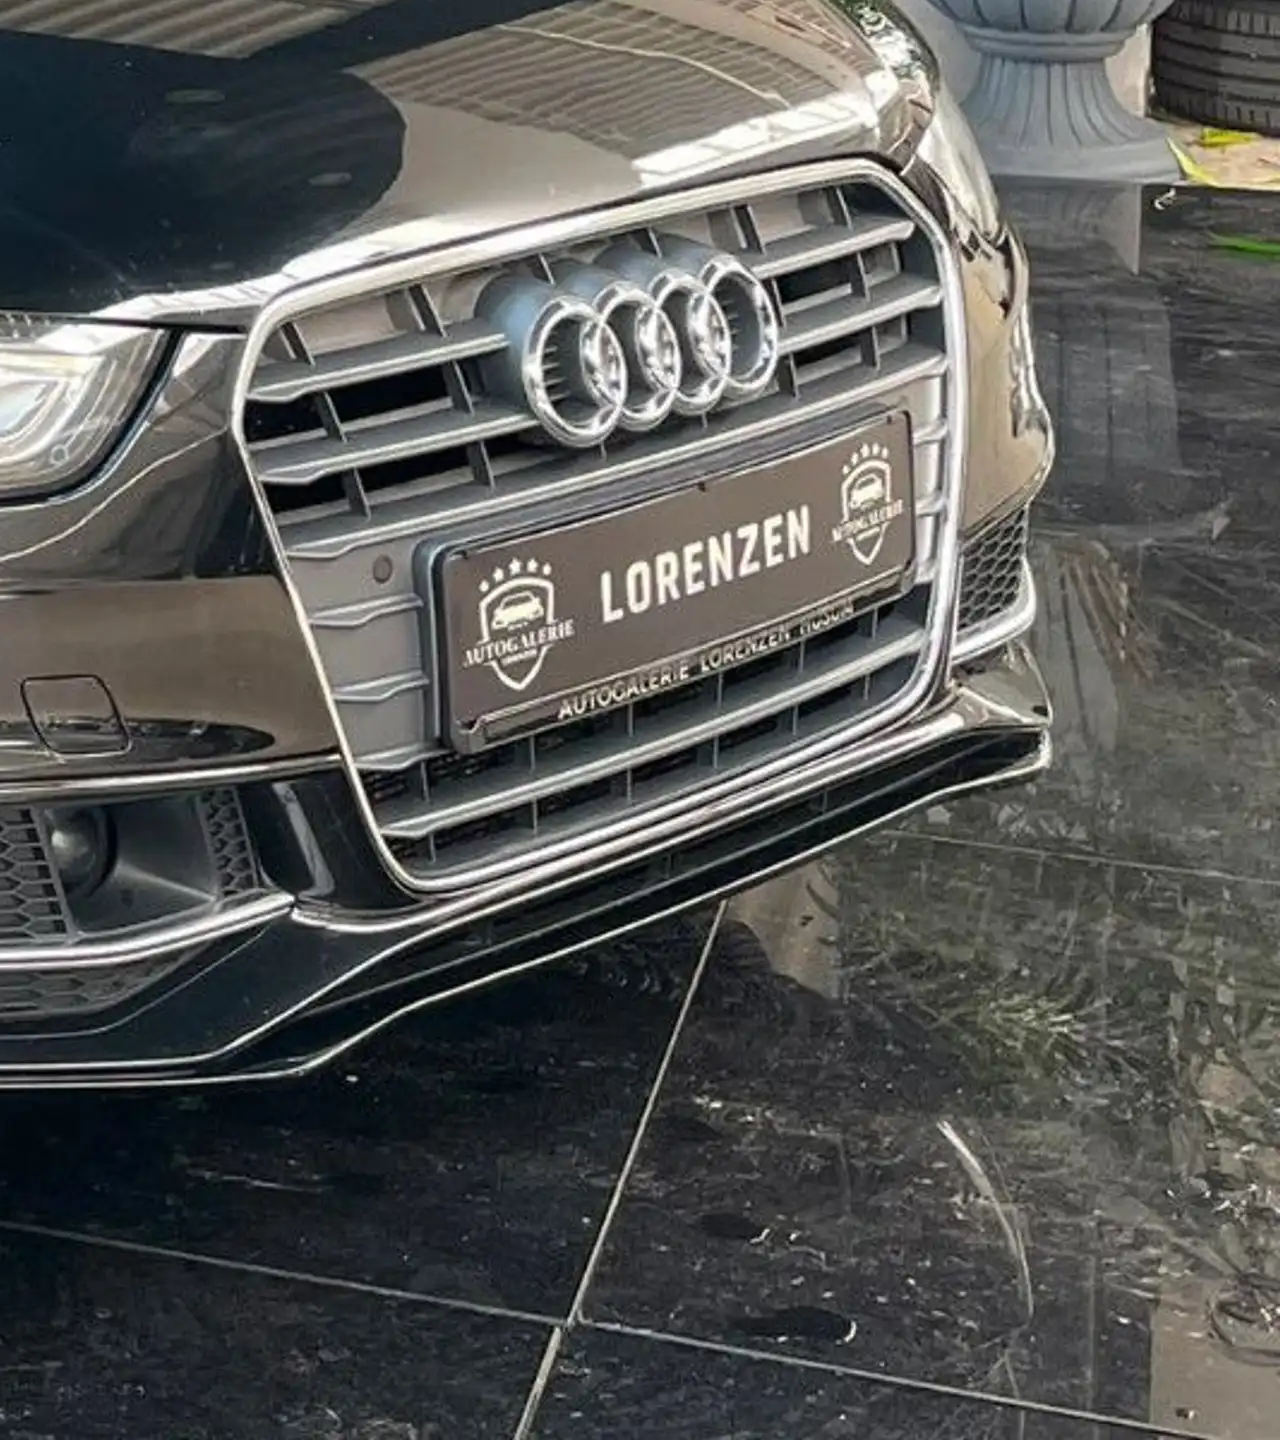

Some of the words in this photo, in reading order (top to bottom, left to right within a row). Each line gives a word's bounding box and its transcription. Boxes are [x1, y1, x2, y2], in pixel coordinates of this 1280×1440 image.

[600, 505, 811, 623] LORENZEN
[463, 618, 576, 668] AUTOGALERIE
[557, 658, 690, 720] AUTOGALERIE
